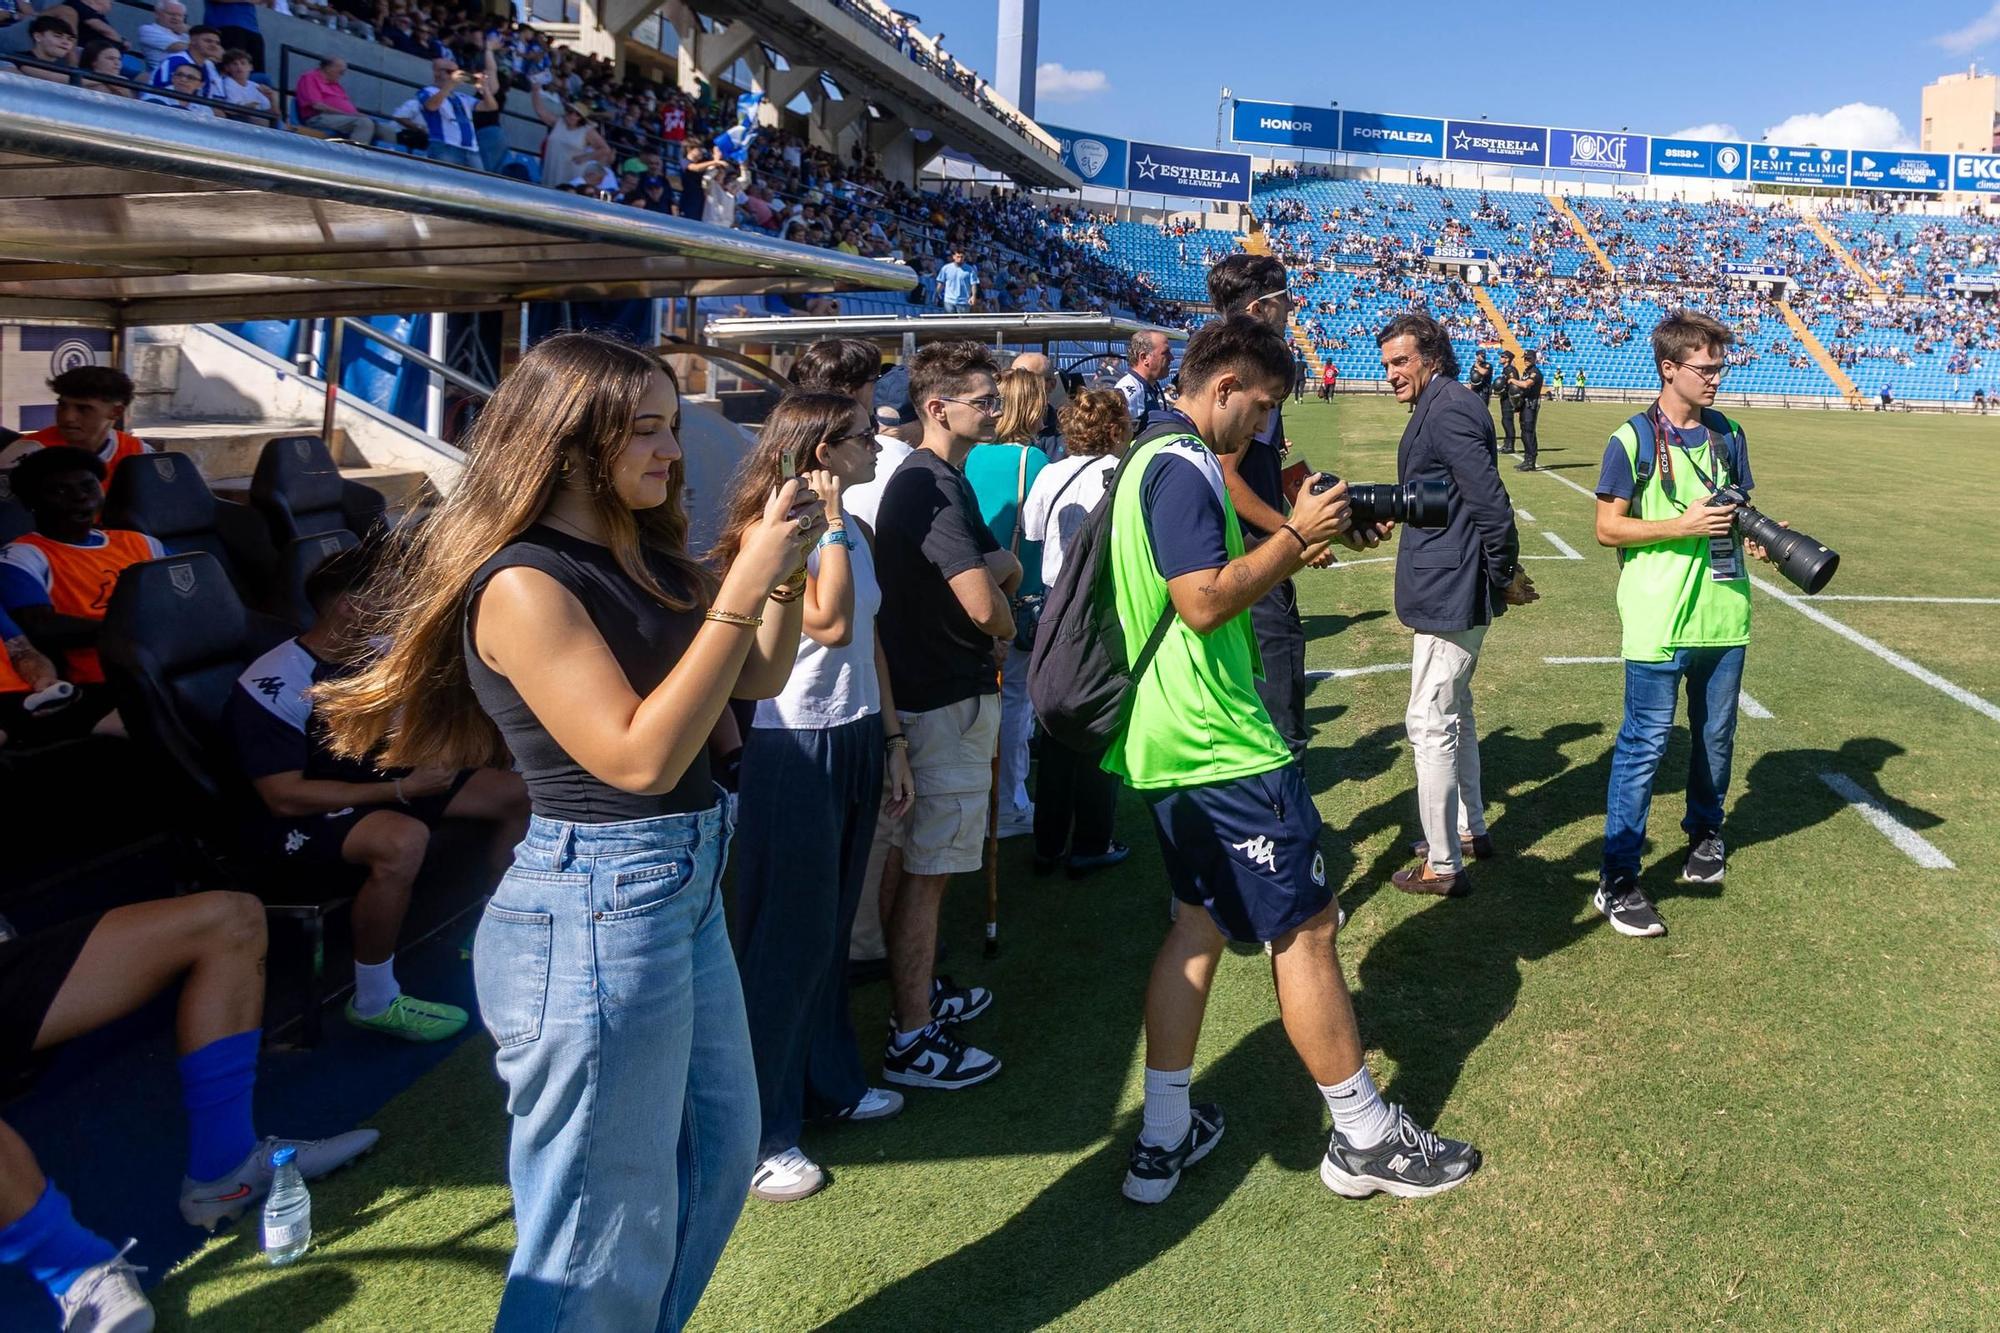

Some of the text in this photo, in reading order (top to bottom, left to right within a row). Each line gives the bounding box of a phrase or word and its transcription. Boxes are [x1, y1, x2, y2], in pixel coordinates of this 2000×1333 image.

[1260, 117, 1313, 133] HONOR
[1353, 127, 1433, 144] FORTALEZA
[1472, 137, 1540, 152] ESTRELLA
[1497, 148, 1525, 156] LEVANTE
[1570, 133, 1627, 162] JORGE
[1160, 164, 1241, 184] ESTRELLA
[1752, 159, 1793, 171] ZENIT
[1799, 162, 1846, 174] CLINIC
[1189, 178, 1222, 188] LEVANTE
[1434, 247, 1466, 257] asisa
[1660, 454, 1669, 473] EOS
[1387, 1154, 1411, 1174] N
